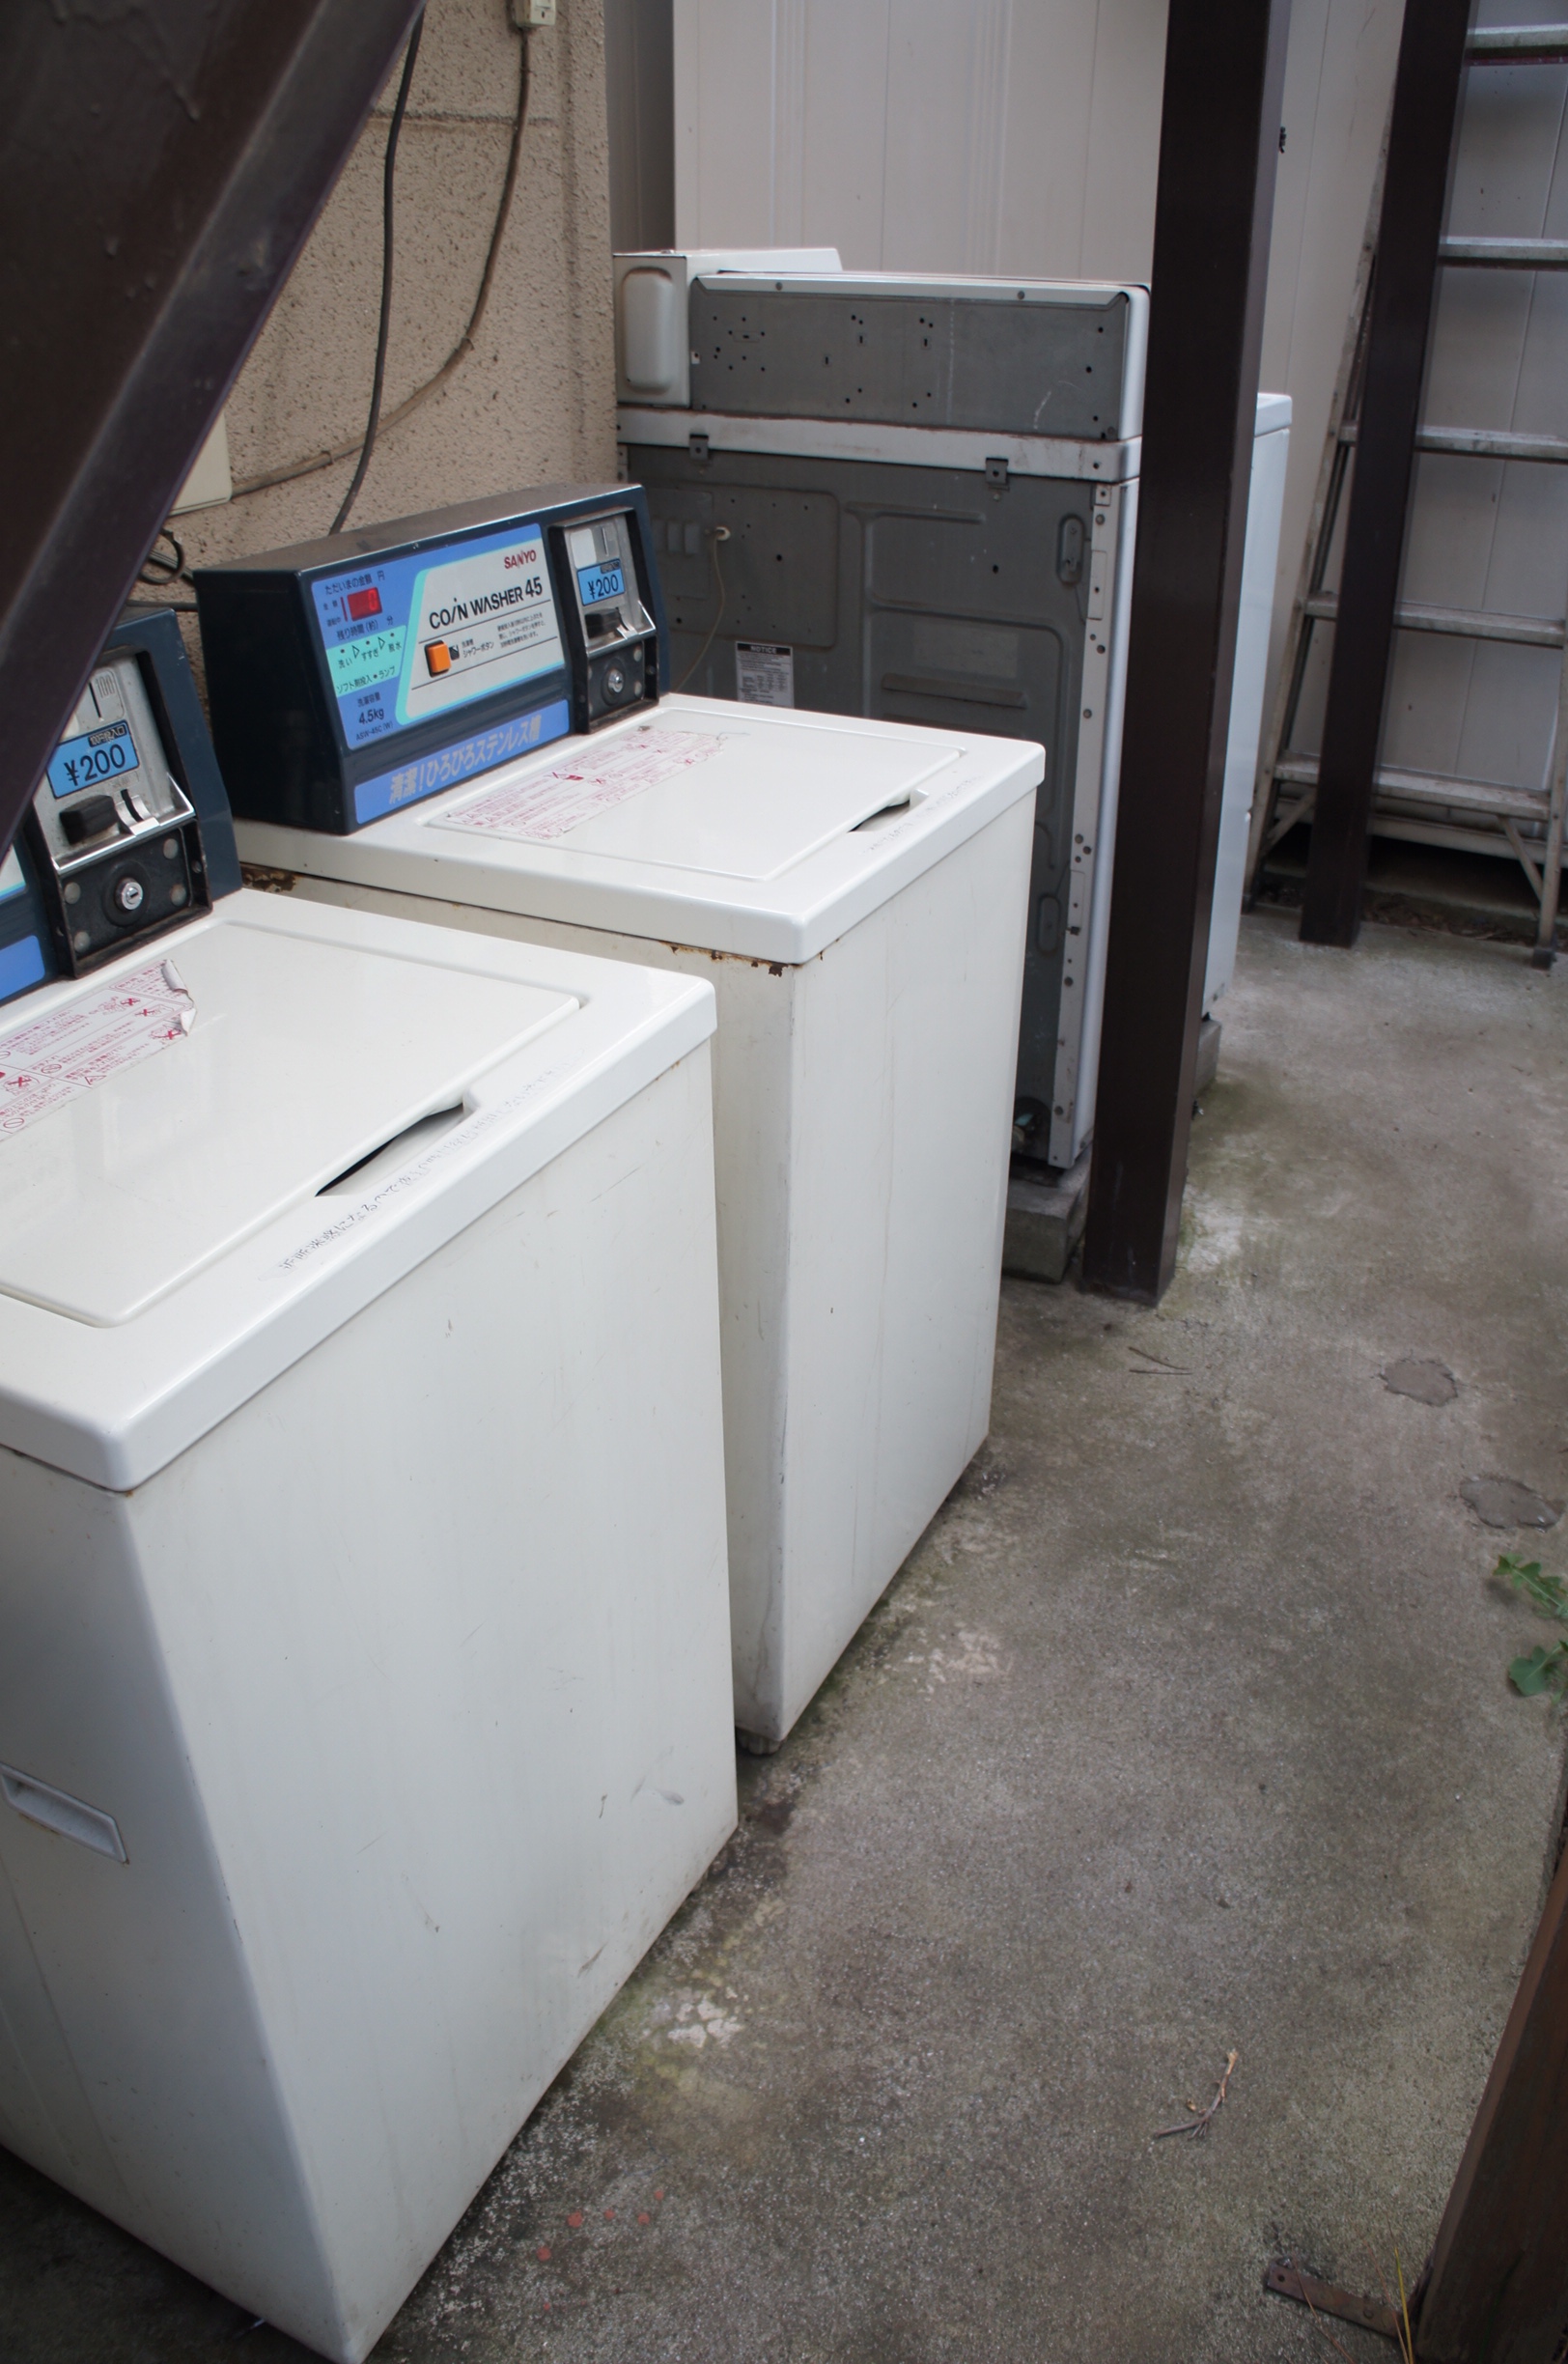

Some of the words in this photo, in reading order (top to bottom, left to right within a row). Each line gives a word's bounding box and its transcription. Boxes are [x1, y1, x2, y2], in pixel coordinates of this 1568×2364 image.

[503, 549, 538, 570] SANYO
[324, 574, 373, 595] ただいまの金額
[377, 570, 385, 581] 円
[587, 574, 619, 600] ¥200
[469, 585, 523, 616] WASHER
[525, 576, 543, 598] 45
[462, 641, 494, 659] シャワーボタン
[358, 708, 384, 725] 4.5kg
[64, 744, 126, 786] ¥200
